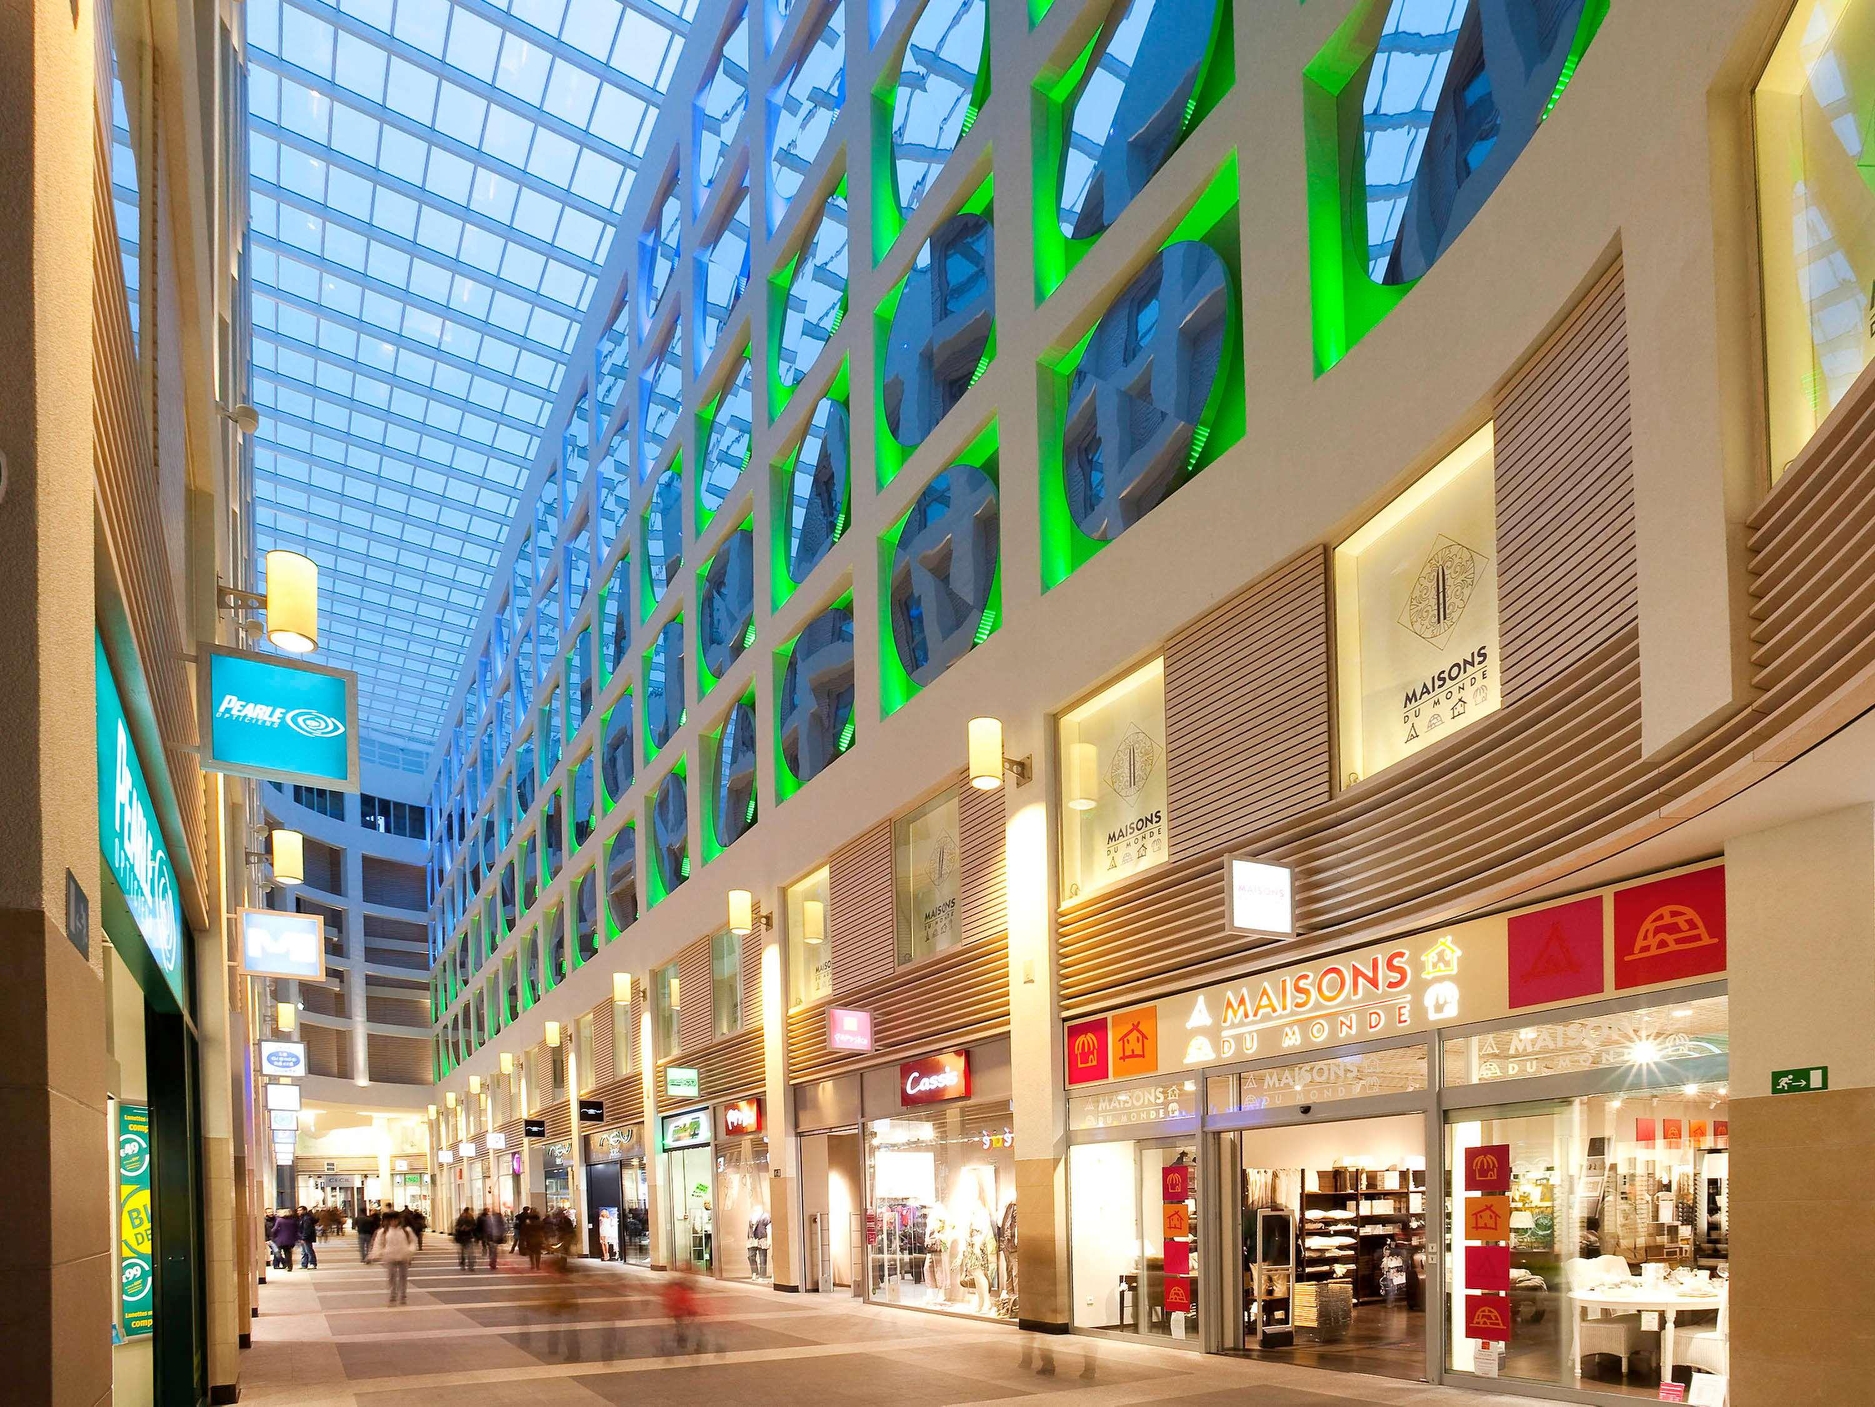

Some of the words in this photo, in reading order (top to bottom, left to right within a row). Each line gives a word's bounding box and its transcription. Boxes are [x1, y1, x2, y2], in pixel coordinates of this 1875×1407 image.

[1403, 645, 1488, 709] MAISONS
[218, 694, 287, 724] PEARLE
[1403, 707, 1421, 725] DU
[1432, 669, 1488, 709] MONDE
[215, 710, 281, 729] OPTICIENS
[114, 717, 154, 911] PEARLE
[1106, 809, 1163, 846] MAISONS
[1106, 846, 1119, 857] DU
[1125, 827, 1163, 850] MONDE
[924, 897, 956, 922] MAISONS
[1220, 948, 1412, 1029] MAISONS
[1220, 1032, 1257, 1058] DU
[1282, 1003, 1411, 1048] MONDE
[906, 1065, 958, 1095] Cassis
[1262, 1060, 1358, 1090] MAISONS
[1508, 1060, 1537, 1075] DU
[1098, 1087, 1165, 1112] MAISONS
[1120, 1108, 1165, 1123] MONDE
